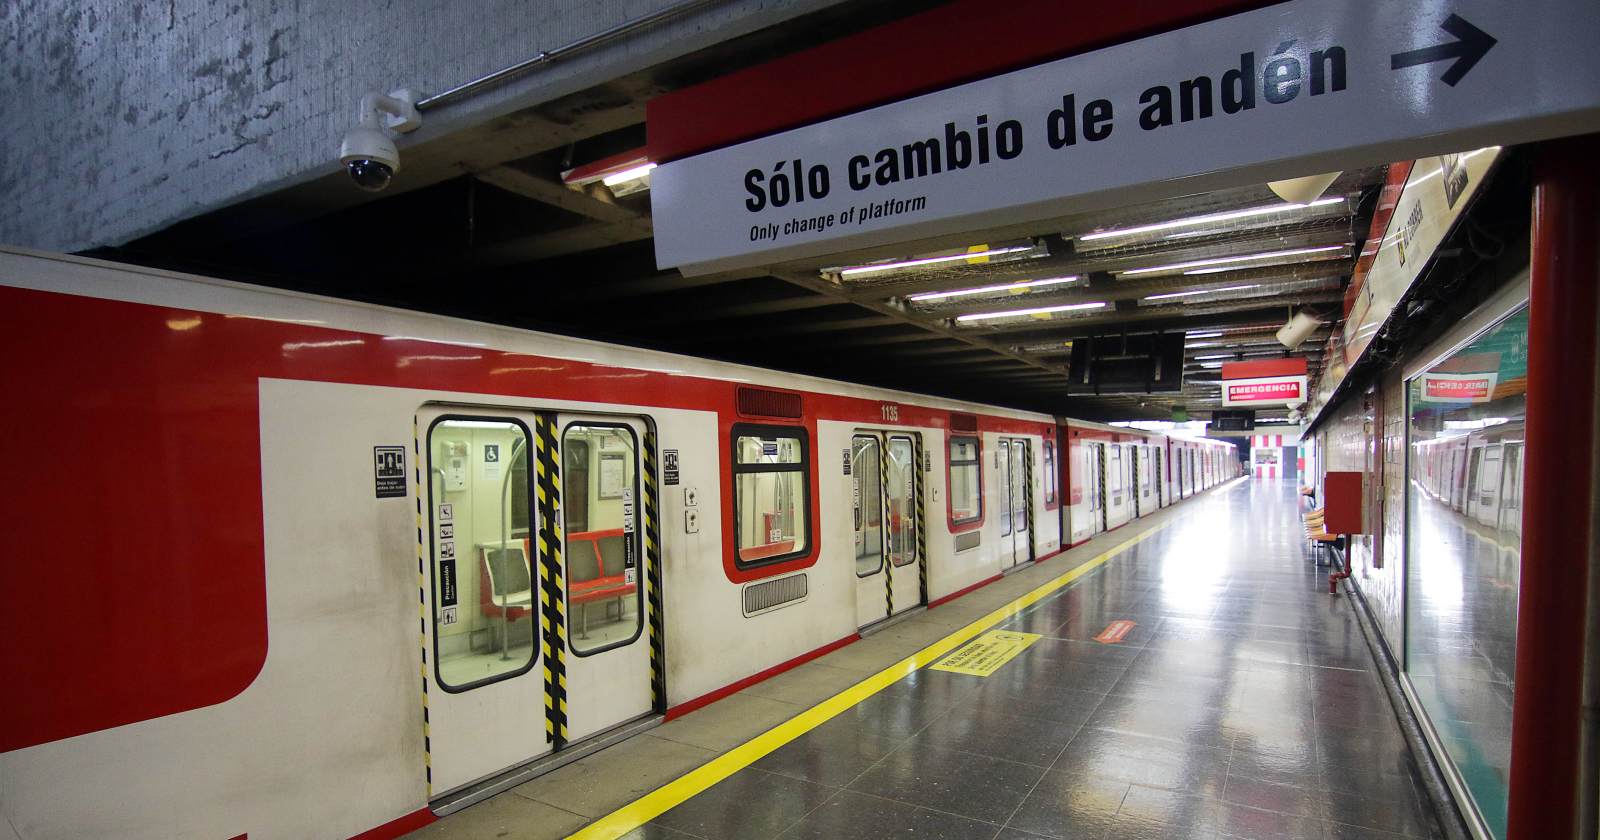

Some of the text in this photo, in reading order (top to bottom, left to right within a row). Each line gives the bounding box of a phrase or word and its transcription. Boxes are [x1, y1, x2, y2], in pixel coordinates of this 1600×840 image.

[744, 39, 1347, 213] Sólo cambio de andén
[750, 196, 926, 242] Only change of platform
[1230, 383, 1297, 394] EMERGENCIA
[881, 405, 898, 421] 1135
